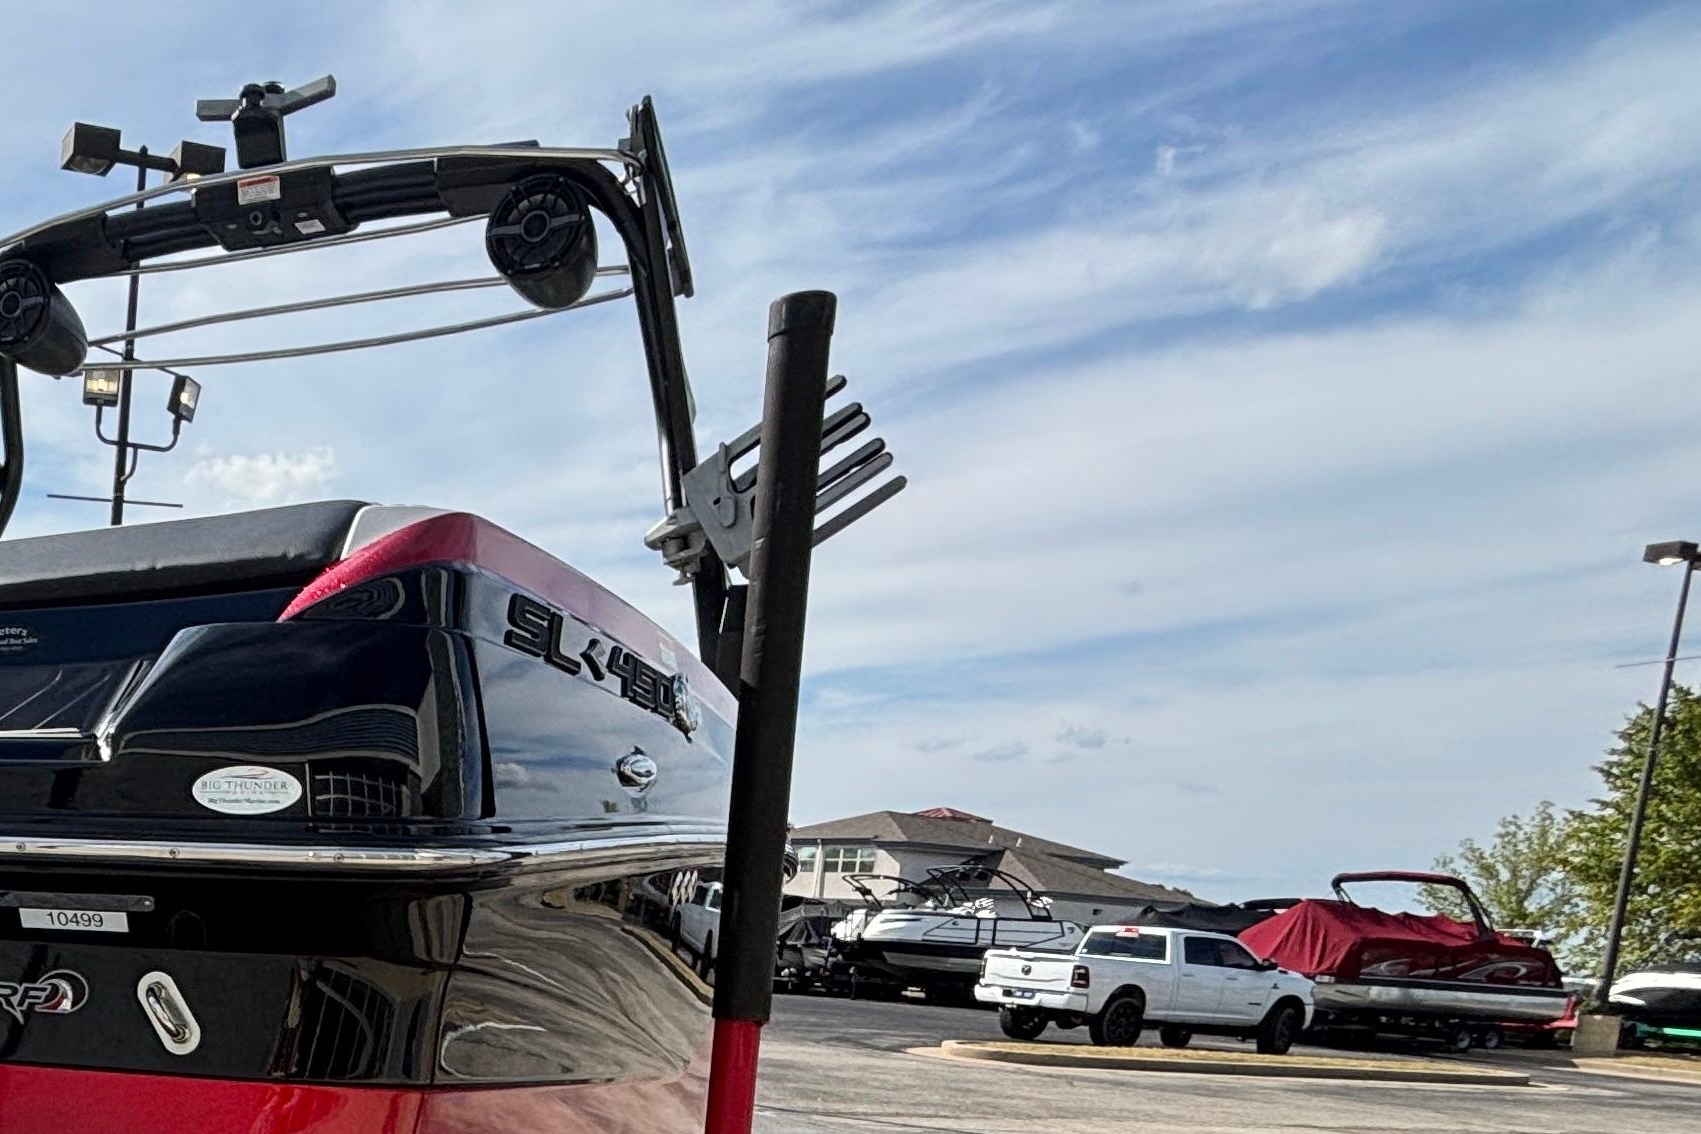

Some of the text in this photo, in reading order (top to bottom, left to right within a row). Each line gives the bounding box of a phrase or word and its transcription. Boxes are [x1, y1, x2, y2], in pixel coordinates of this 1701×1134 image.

[504, 593, 582, 676] SL
[201, 780, 288, 791] BIG THUNDER
[45, 910, 104, 928] 10499
